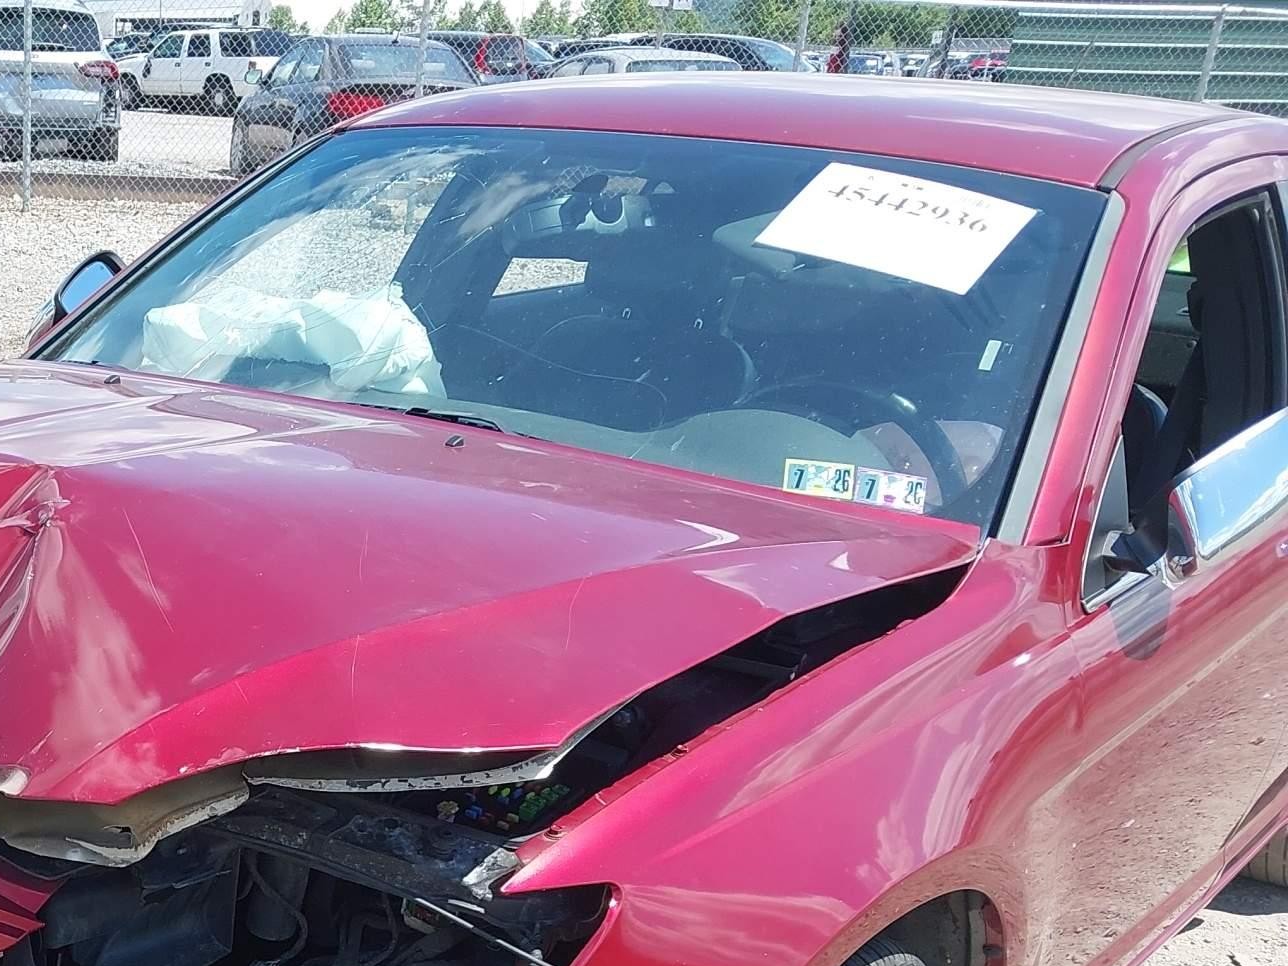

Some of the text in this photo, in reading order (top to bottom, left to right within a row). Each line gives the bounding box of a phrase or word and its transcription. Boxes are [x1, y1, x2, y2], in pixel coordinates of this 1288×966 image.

[828, 184, 988, 233] 45442936
[793, 468, 851, 493] 7 26
[865, 478, 876, 500] 7
